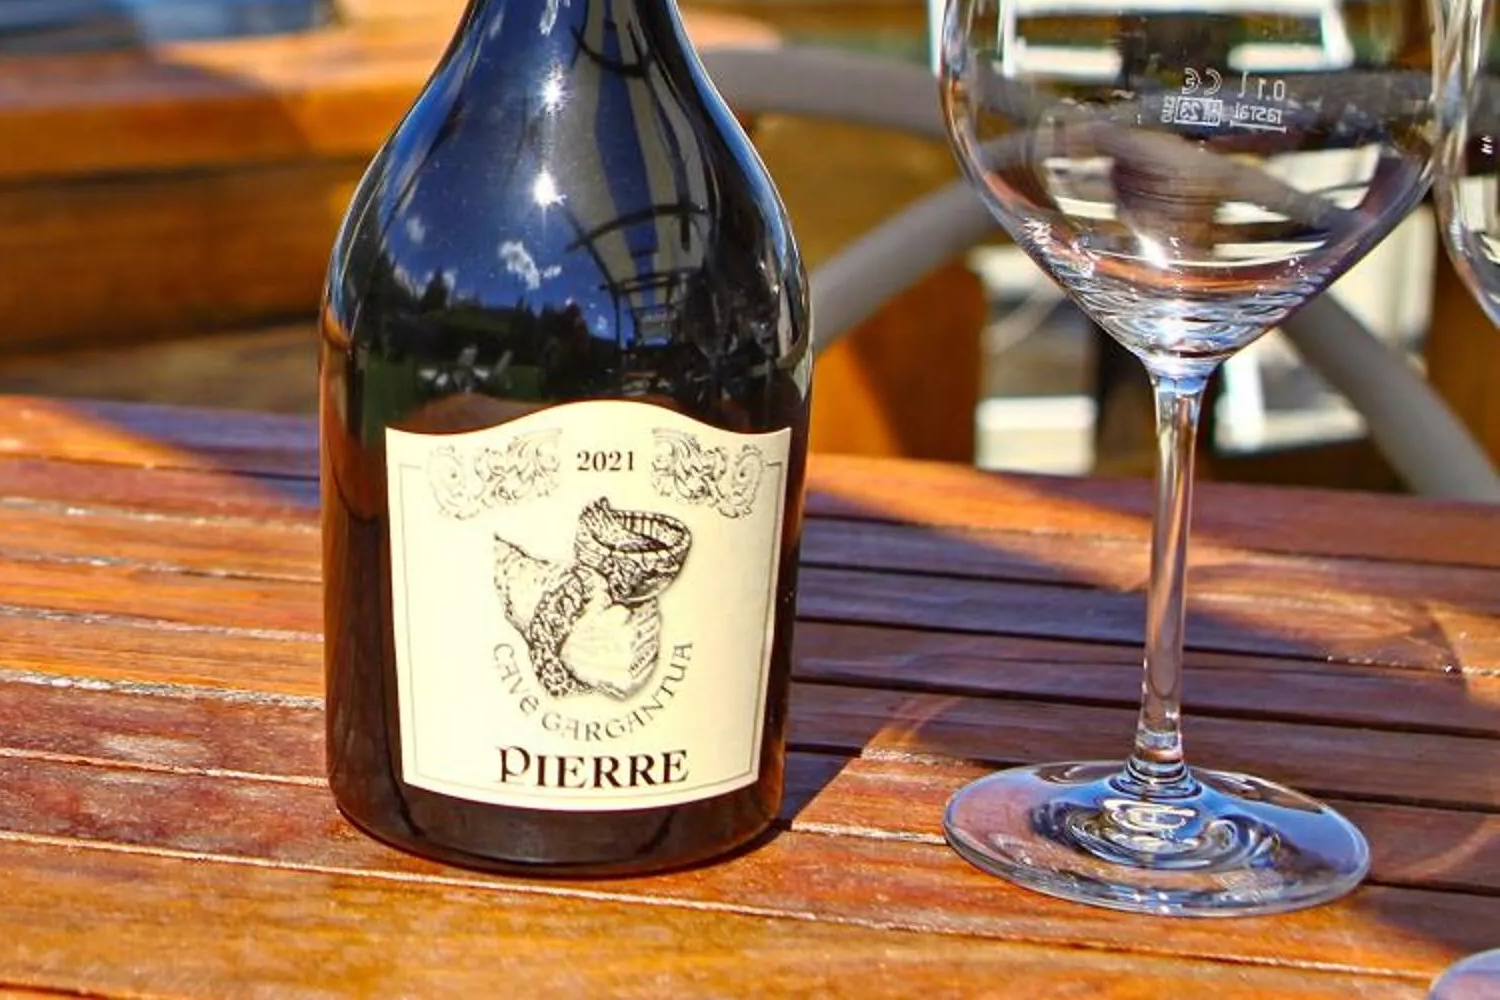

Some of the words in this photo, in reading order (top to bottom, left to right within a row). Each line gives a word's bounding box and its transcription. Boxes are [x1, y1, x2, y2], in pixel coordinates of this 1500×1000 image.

[577, 450, 632, 472] 2021
[541, 643, 693, 741] GARGANTUA
[495, 745, 689, 789] PIERRE
